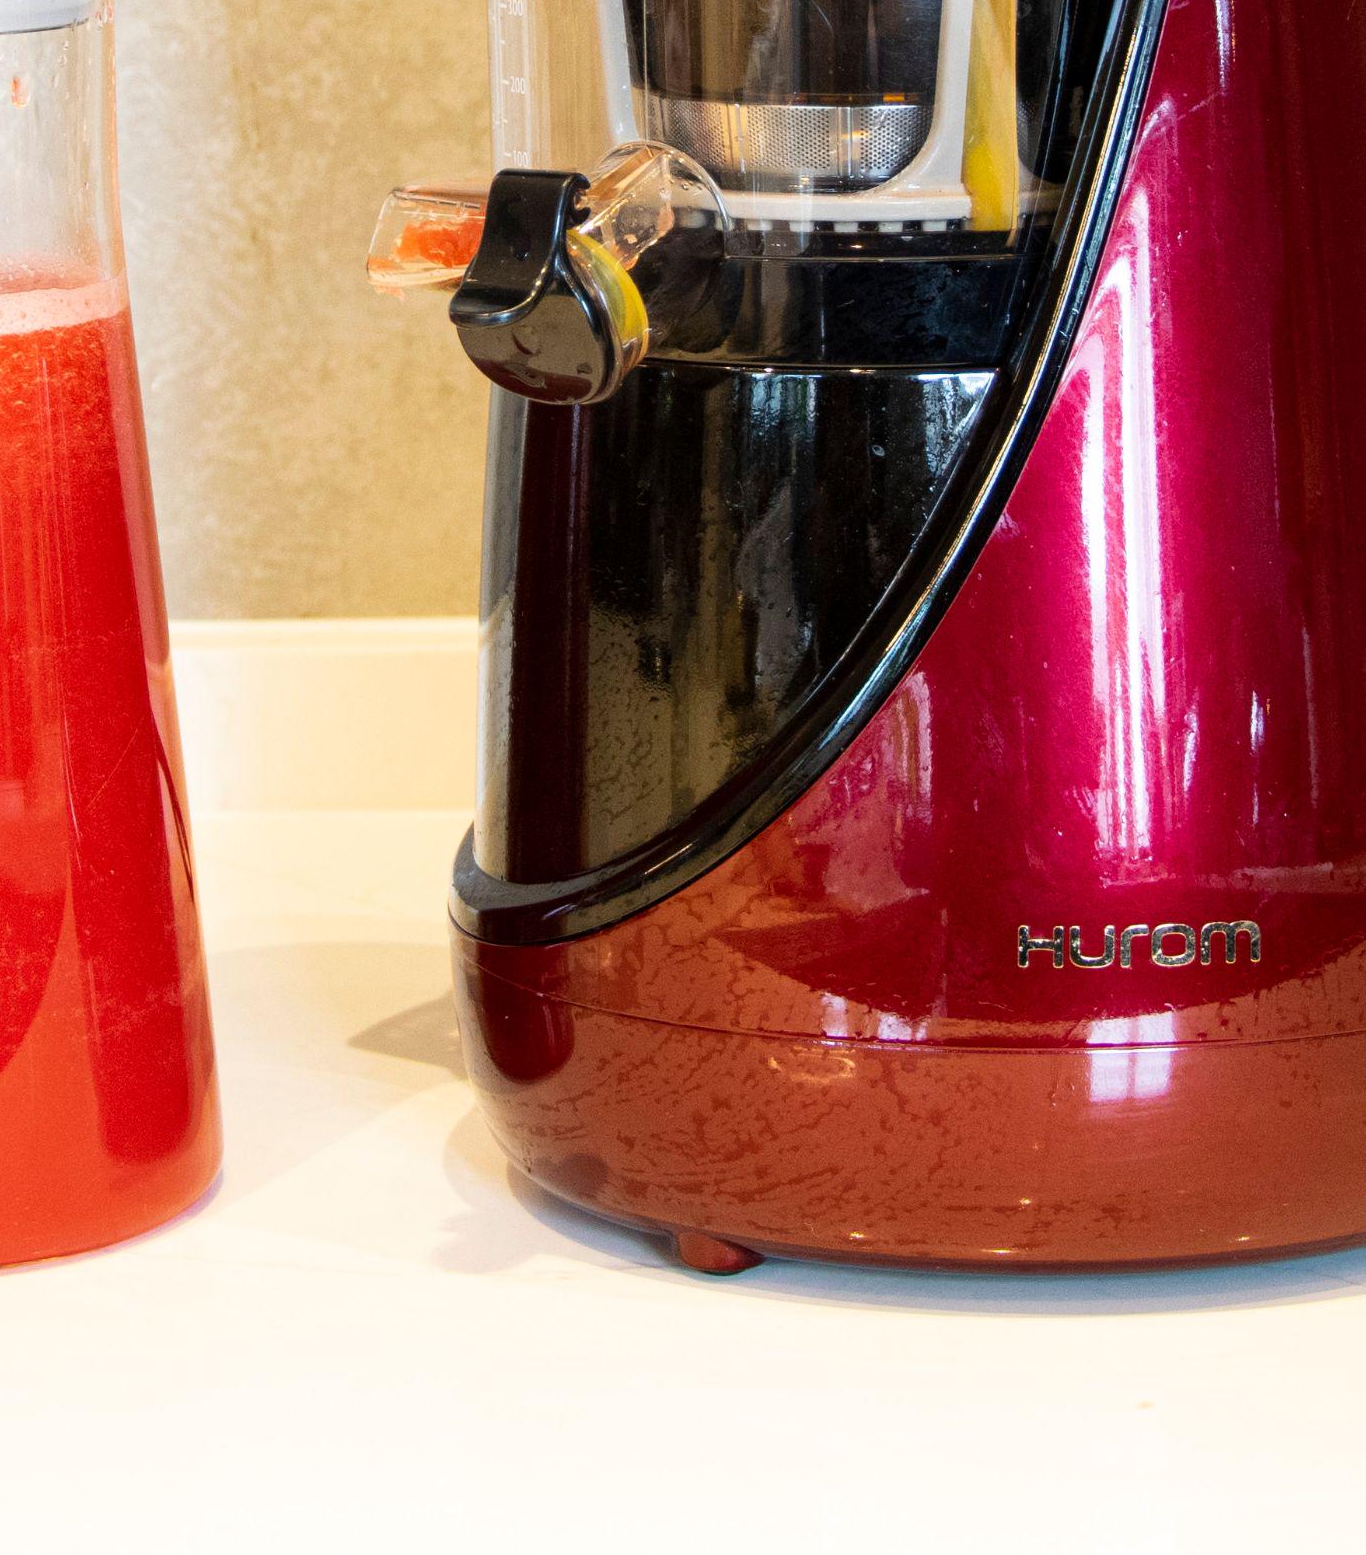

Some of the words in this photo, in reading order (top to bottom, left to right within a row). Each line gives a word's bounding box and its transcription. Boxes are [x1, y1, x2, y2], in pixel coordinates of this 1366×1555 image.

[509, 76, 525, 95] 200
[514, 149, 529, 167] 100
[1017, 920, 1261, 969] Hurom
